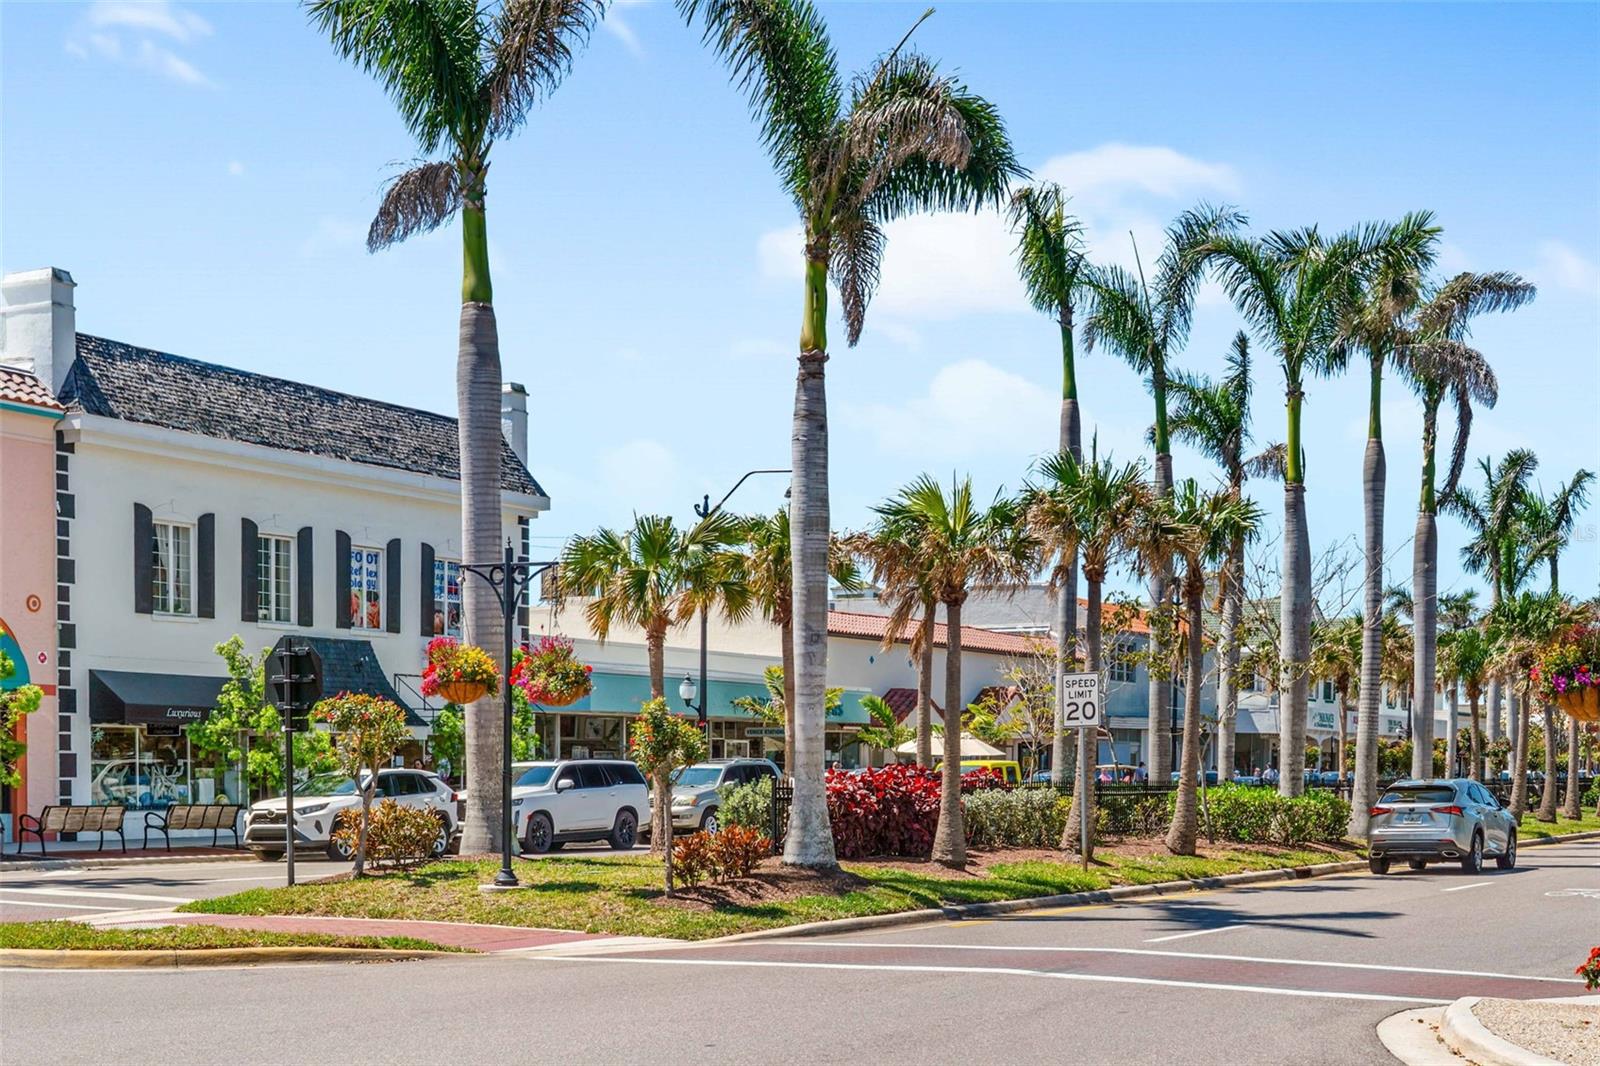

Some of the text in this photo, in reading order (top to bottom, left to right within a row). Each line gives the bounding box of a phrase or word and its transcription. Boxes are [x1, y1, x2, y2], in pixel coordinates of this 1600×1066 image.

[1065, 679, 1096, 688] SPEED
[1068, 690, 1093, 699] LIMIT
[166, 707, 202, 719] Luxurious
[1066, 701, 1096, 720] 20
